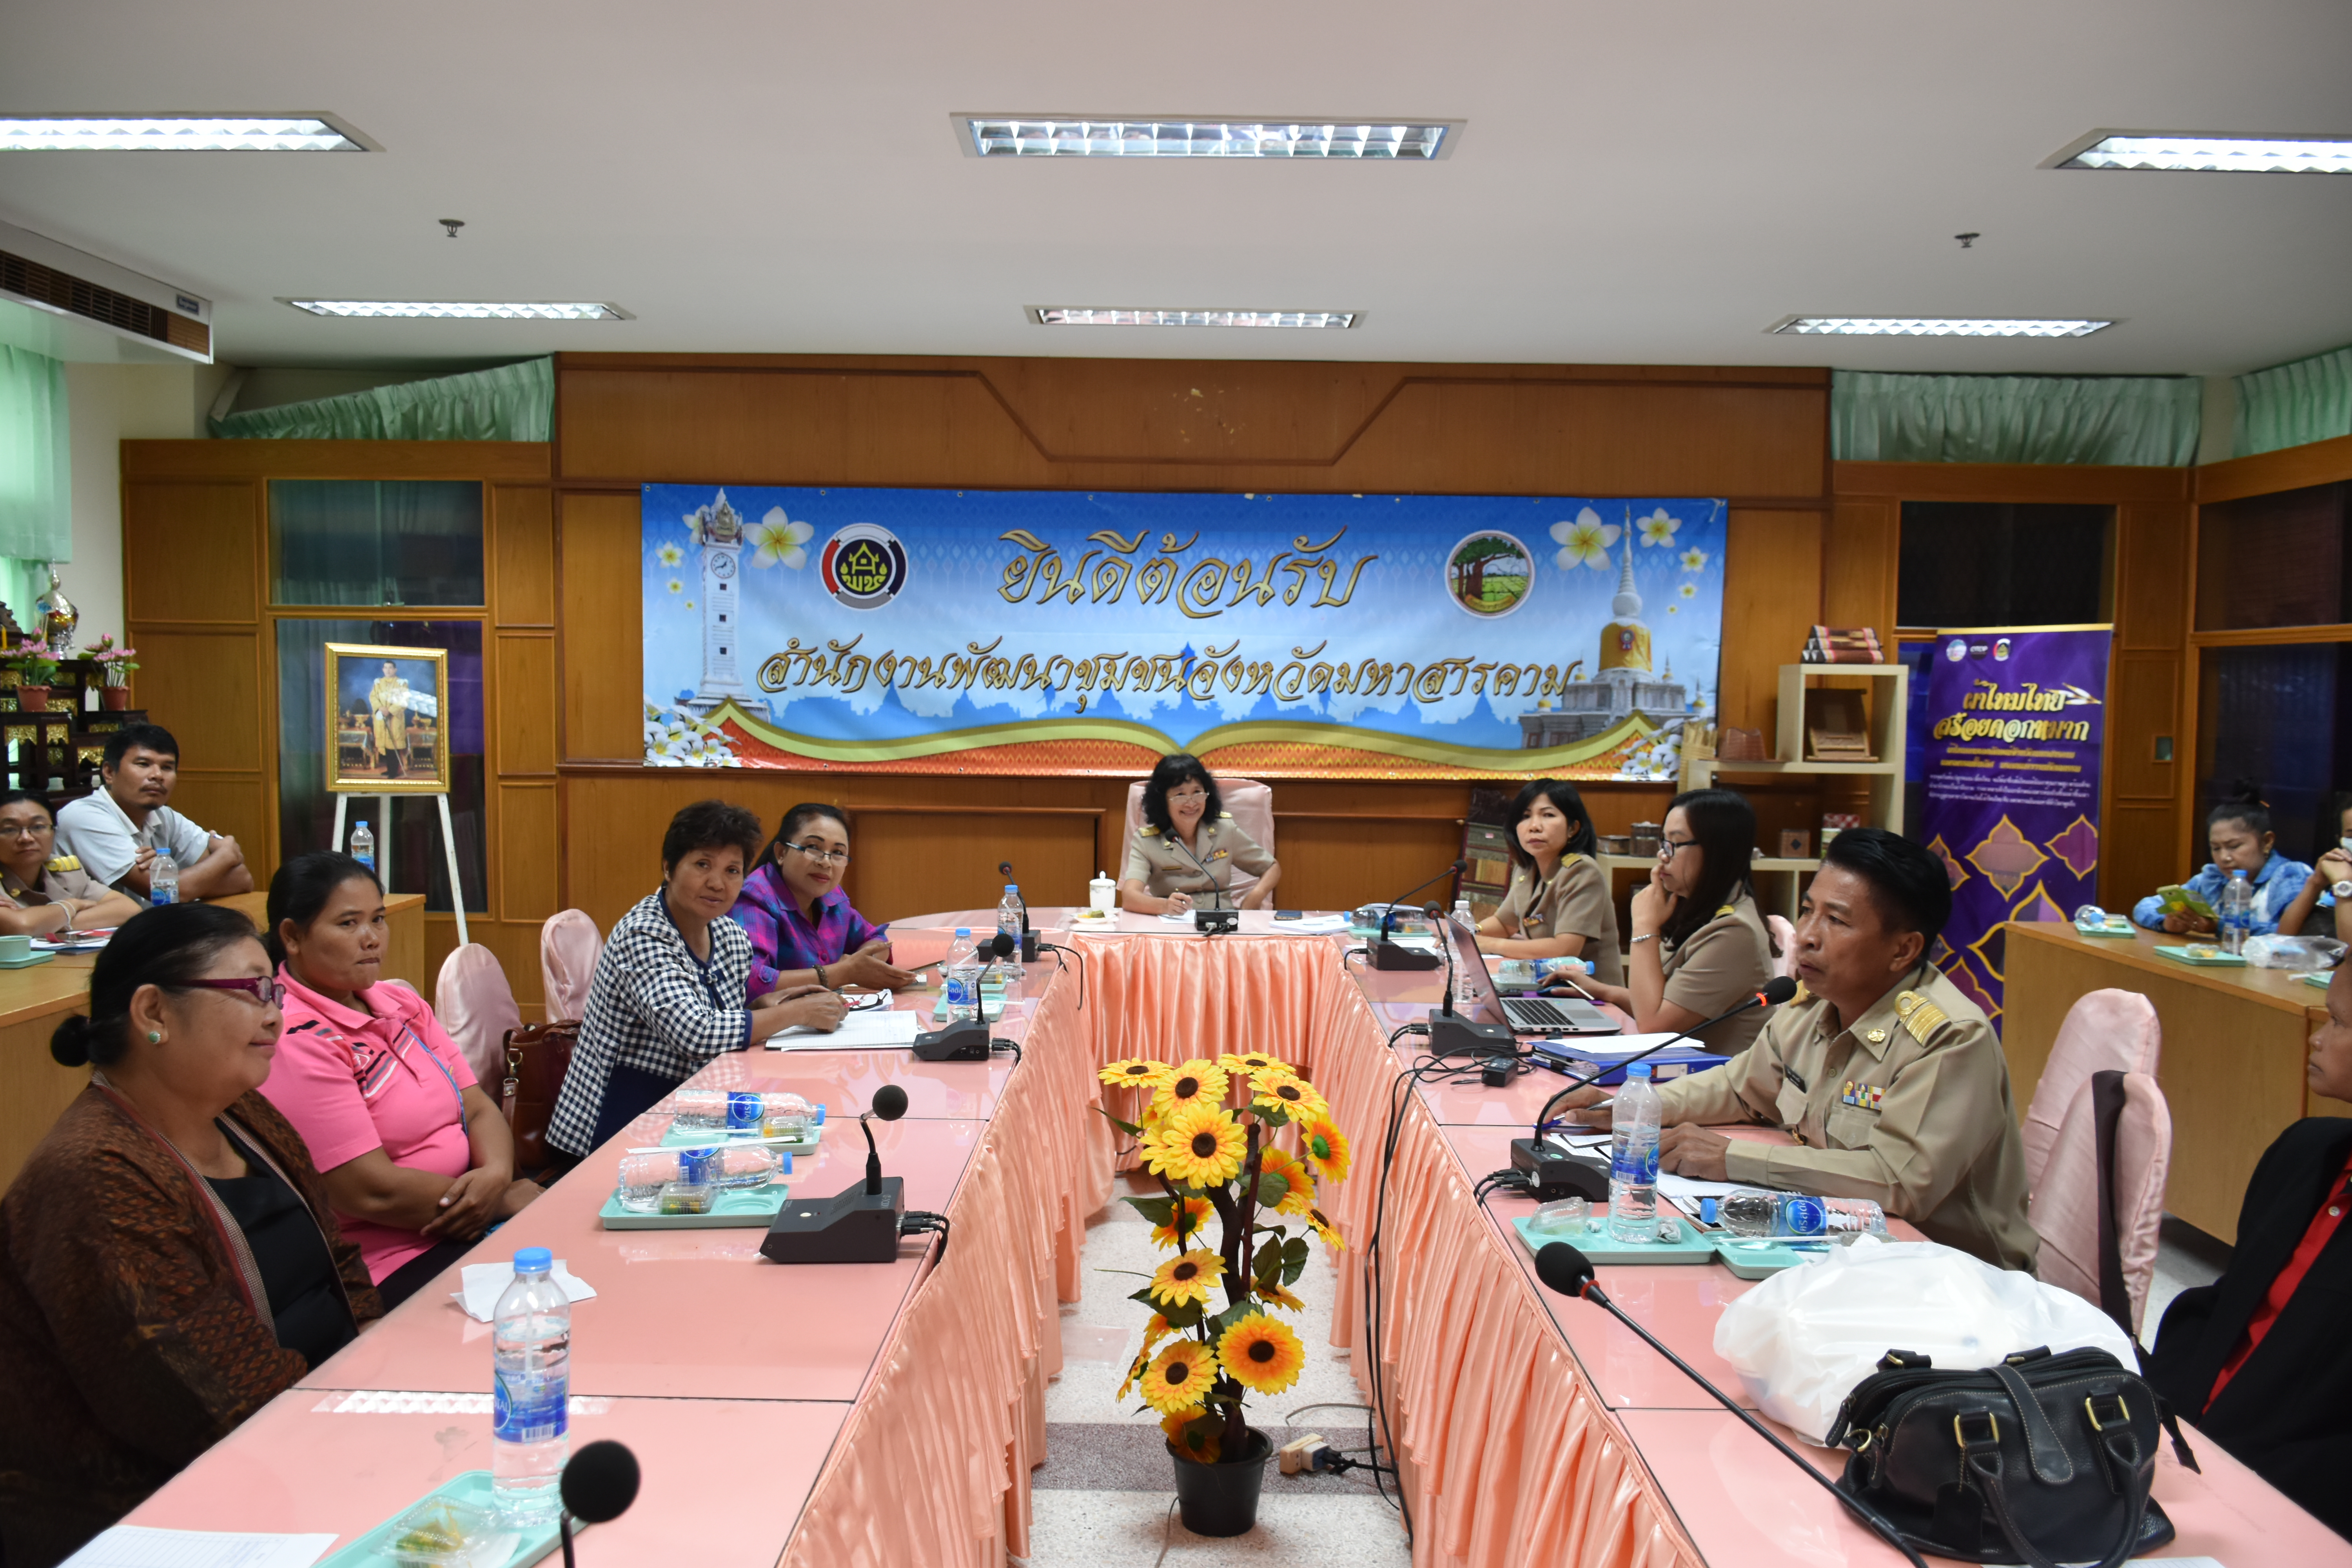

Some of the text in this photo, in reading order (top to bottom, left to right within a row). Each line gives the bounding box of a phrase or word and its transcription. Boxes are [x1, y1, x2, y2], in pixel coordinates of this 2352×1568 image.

[997, 524, 1379, 619] ยินดีต้อนรับ
[756, 633, 1583, 714] สำนักงานพัฒนาชุมชนจังหวัดมหาสารคาม
